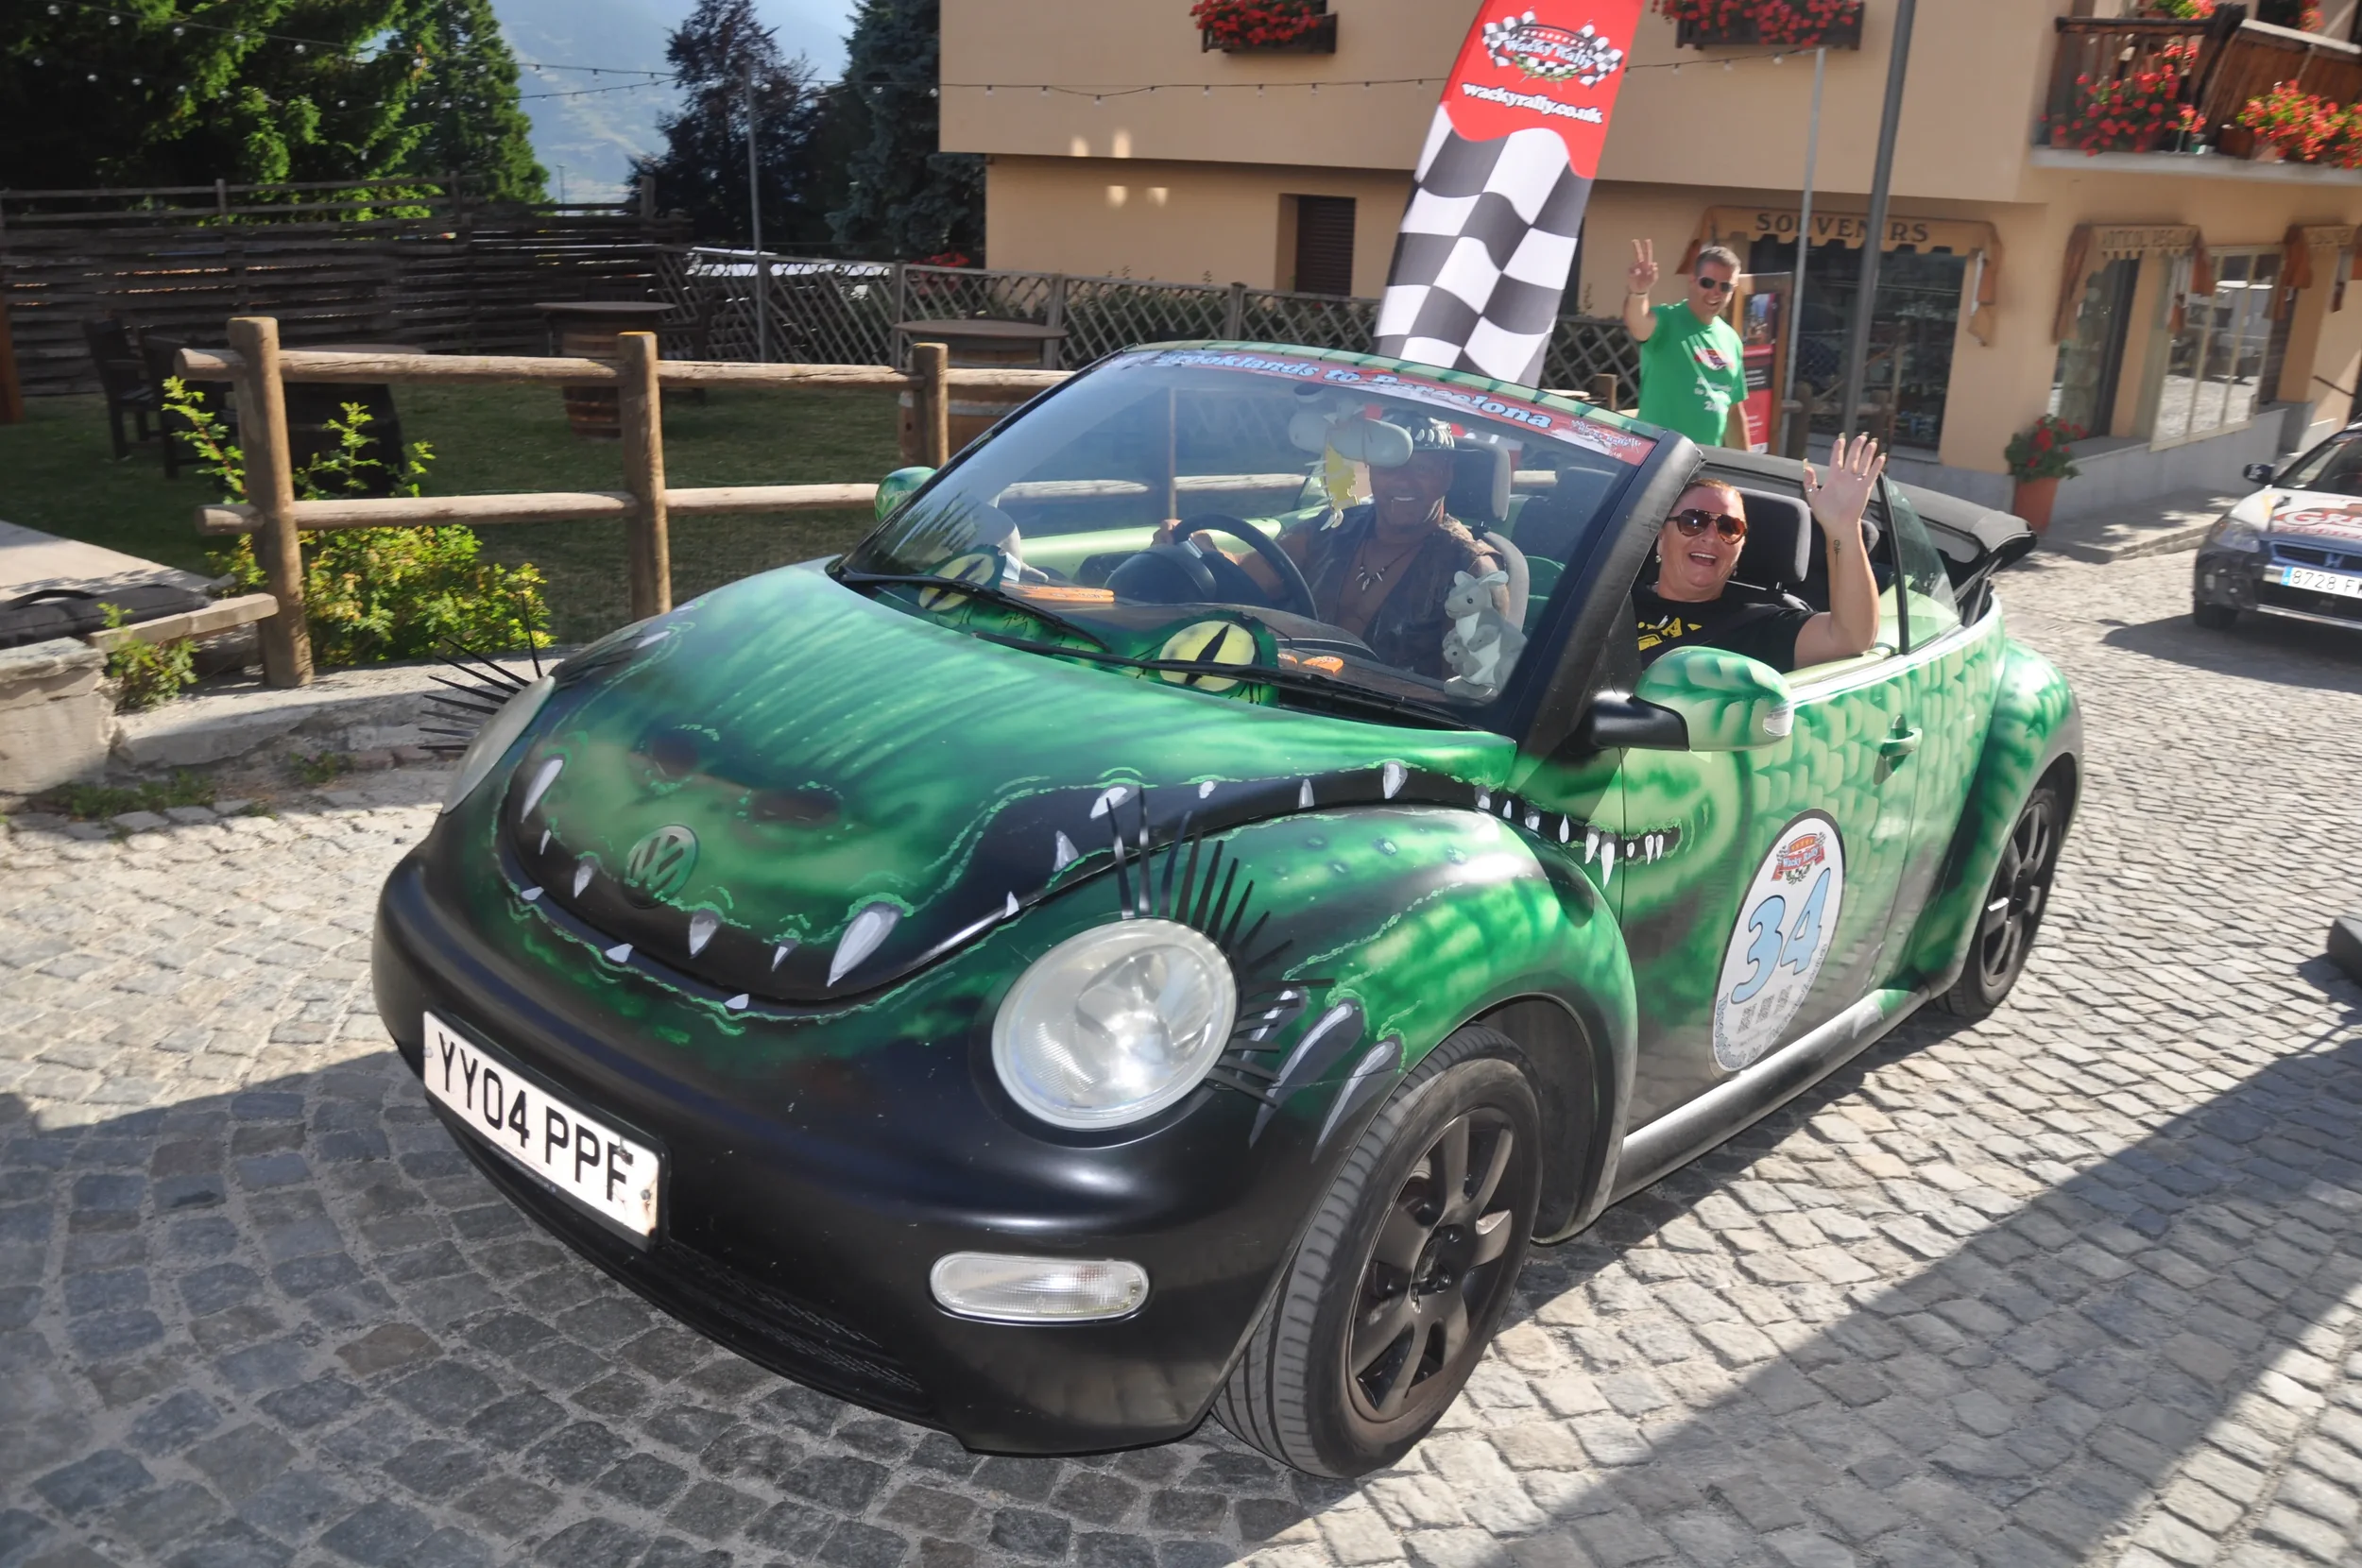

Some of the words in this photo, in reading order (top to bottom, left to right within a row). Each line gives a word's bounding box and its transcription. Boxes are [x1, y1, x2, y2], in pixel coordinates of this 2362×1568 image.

[1503, 36, 1553, 57] Wacky
[1554, 43, 1596, 69] Rally
[1462, 82, 1603, 124] wackyrally.co.uk
[1755, 213, 1929, 243] SOVENRS
[1324, 368, 1361, 383] to
[2292, 571, 2336, 590] 8728
[1730, 867, 1831, 1005] 34
[438, 1031, 529, 1150] YY04
[545, 1105, 634, 1202] PPF
